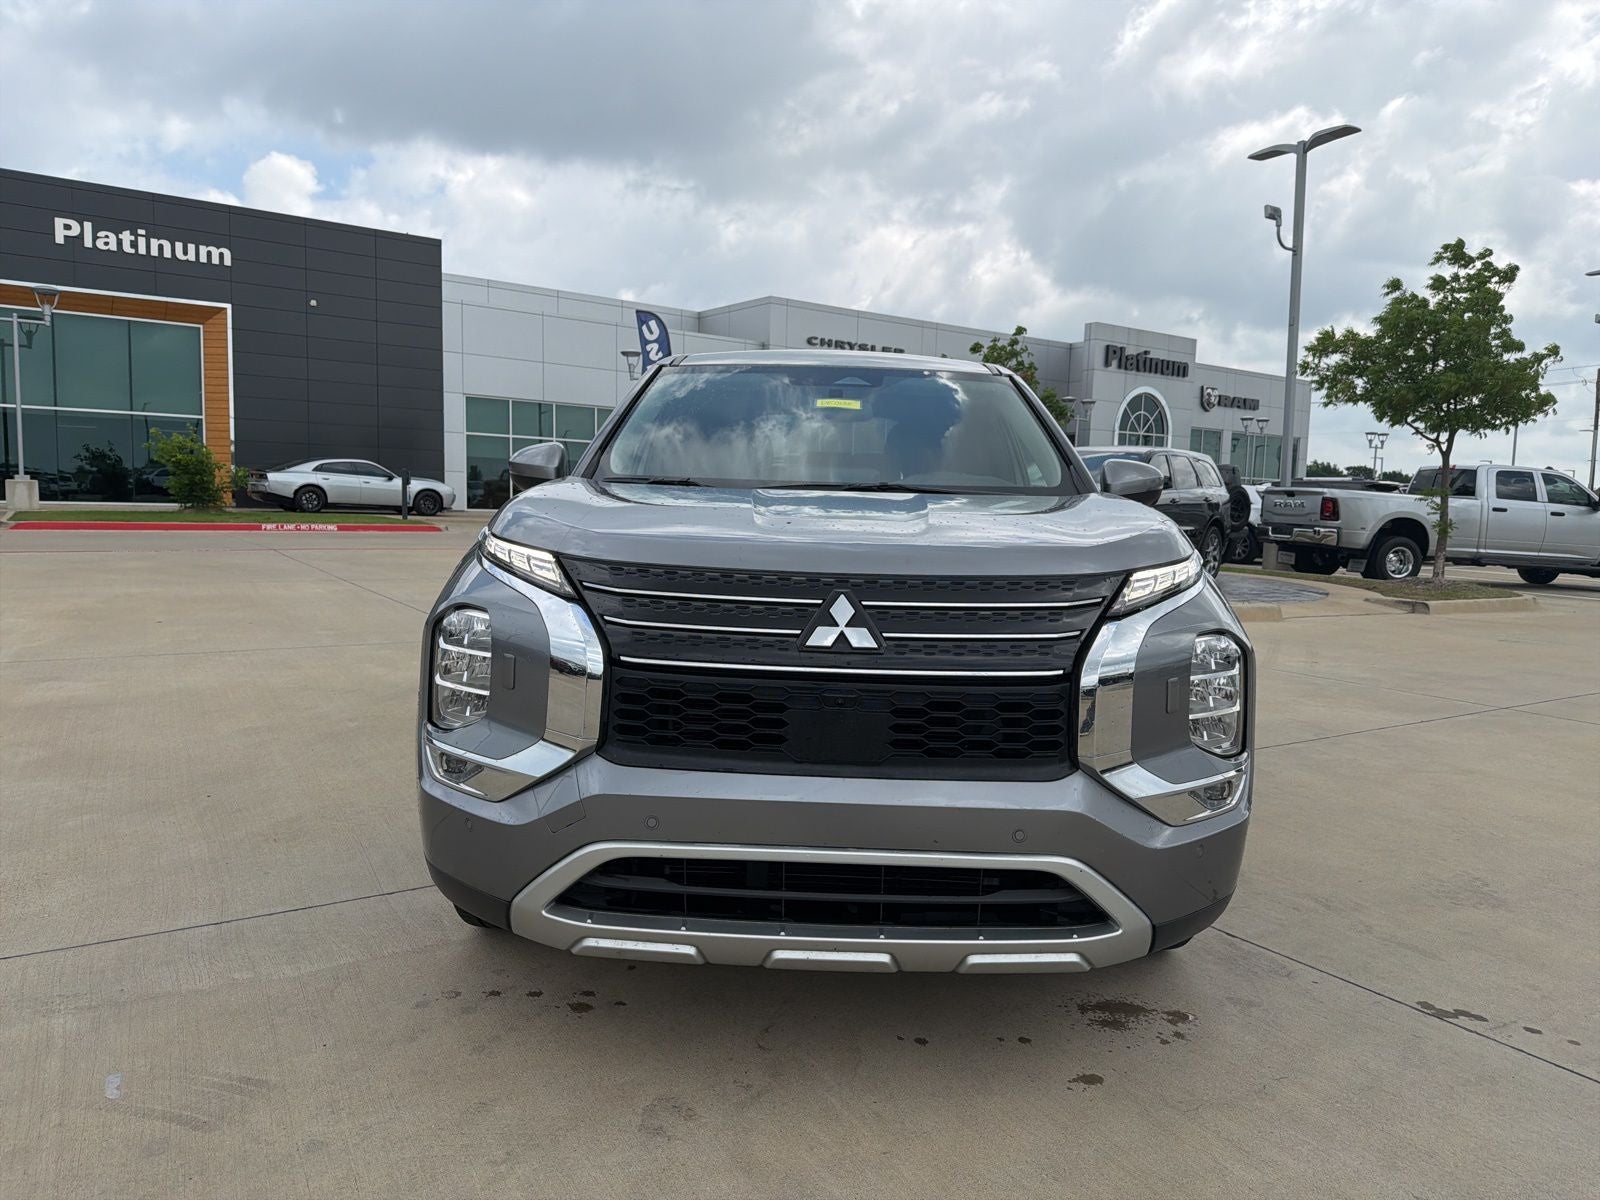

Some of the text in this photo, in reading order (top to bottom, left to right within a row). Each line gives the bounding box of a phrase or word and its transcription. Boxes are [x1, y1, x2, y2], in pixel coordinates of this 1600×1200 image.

[53, 216, 232, 267] Platinum
[1105, 344, 1189, 378] Platinum
[1218, 394, 1260, 411] RAM
[1273, 499, 1306, 509] RAM
[261, 523, 277, 531] FIRE
[278, 523, 297, 531] LANE
